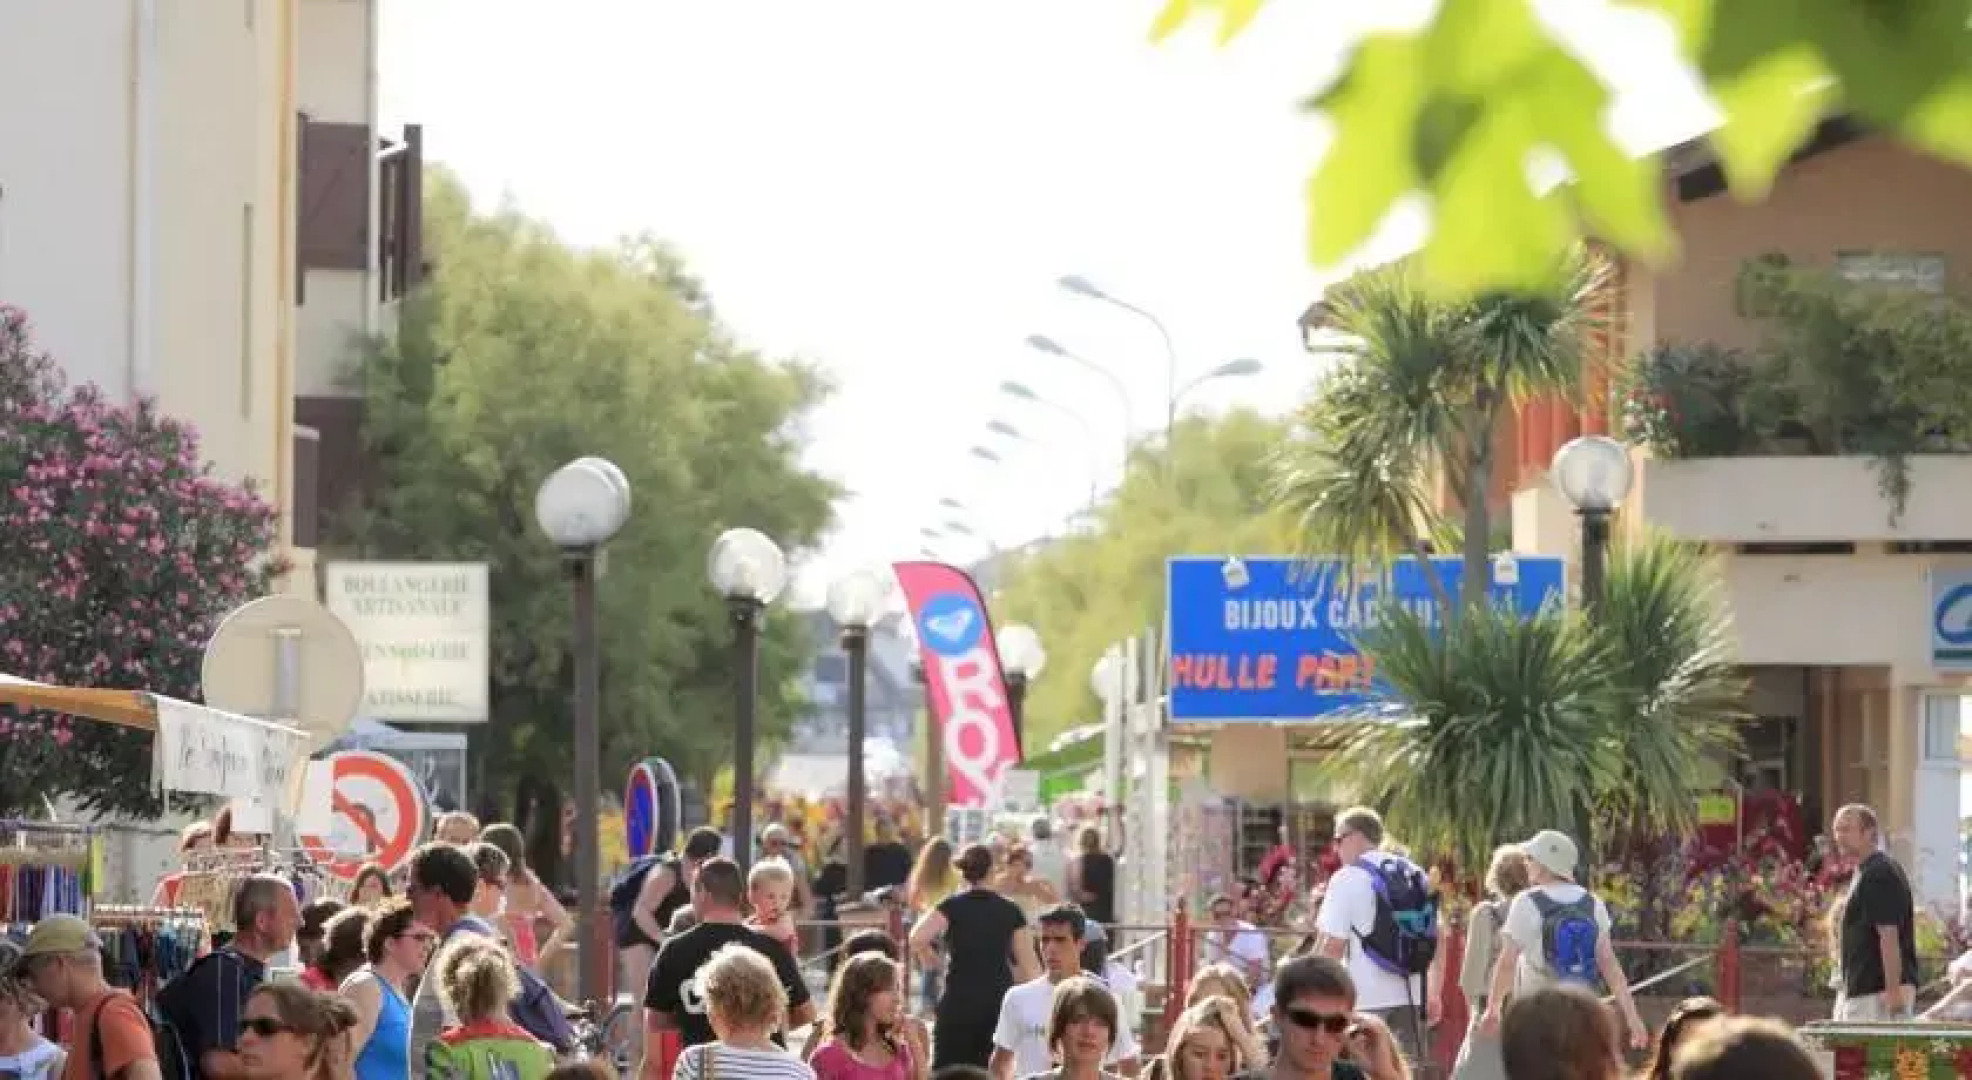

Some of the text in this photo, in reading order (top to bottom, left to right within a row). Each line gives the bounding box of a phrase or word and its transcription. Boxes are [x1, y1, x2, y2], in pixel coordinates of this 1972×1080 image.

[344, 573, 469, 593] BOULANGERIE
[352, 598, 462, 617] ARTISANALE
[1225, 598, 1318, 630] BIJOUX
[366, 690, 456, 706] ATISSERIE
